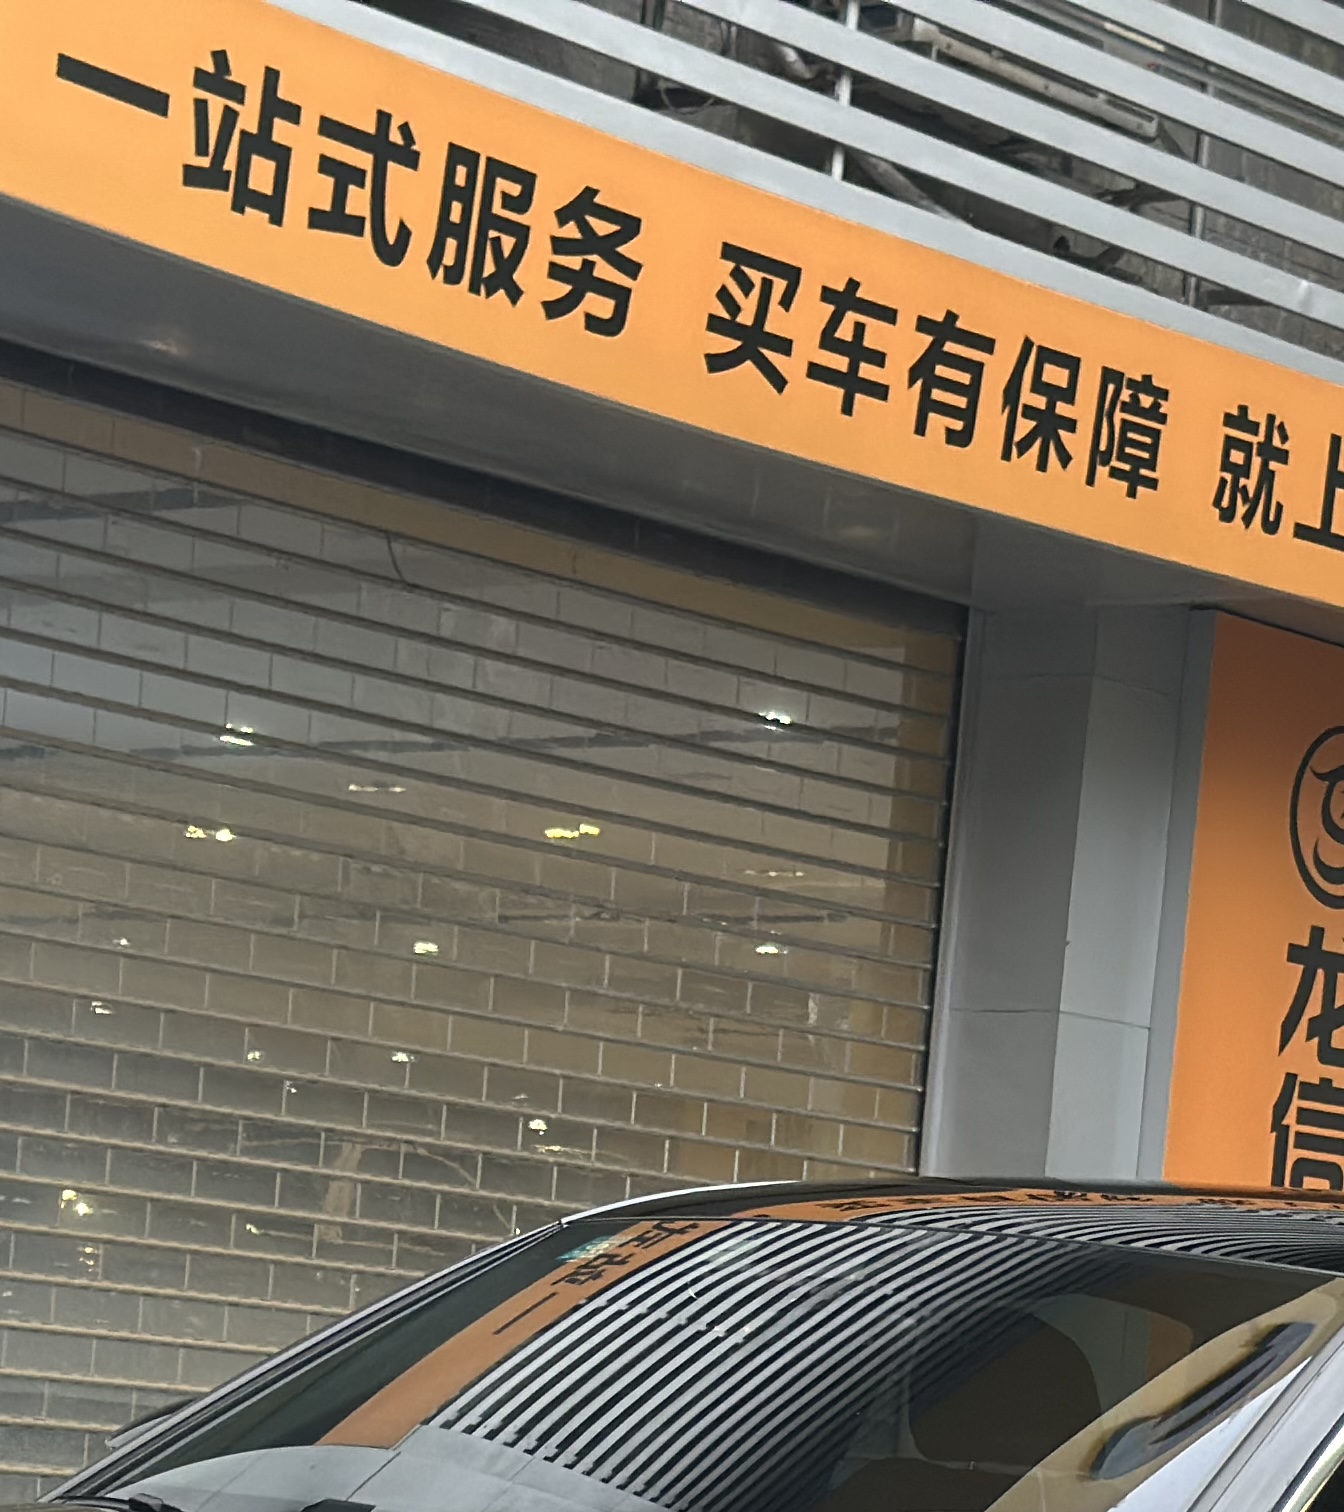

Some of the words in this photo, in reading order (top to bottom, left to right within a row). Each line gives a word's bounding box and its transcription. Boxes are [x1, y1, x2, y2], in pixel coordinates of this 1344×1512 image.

[56, 49, 643, 338] 一站式服务
[704, 241, 1170, 499] 买车有保障
